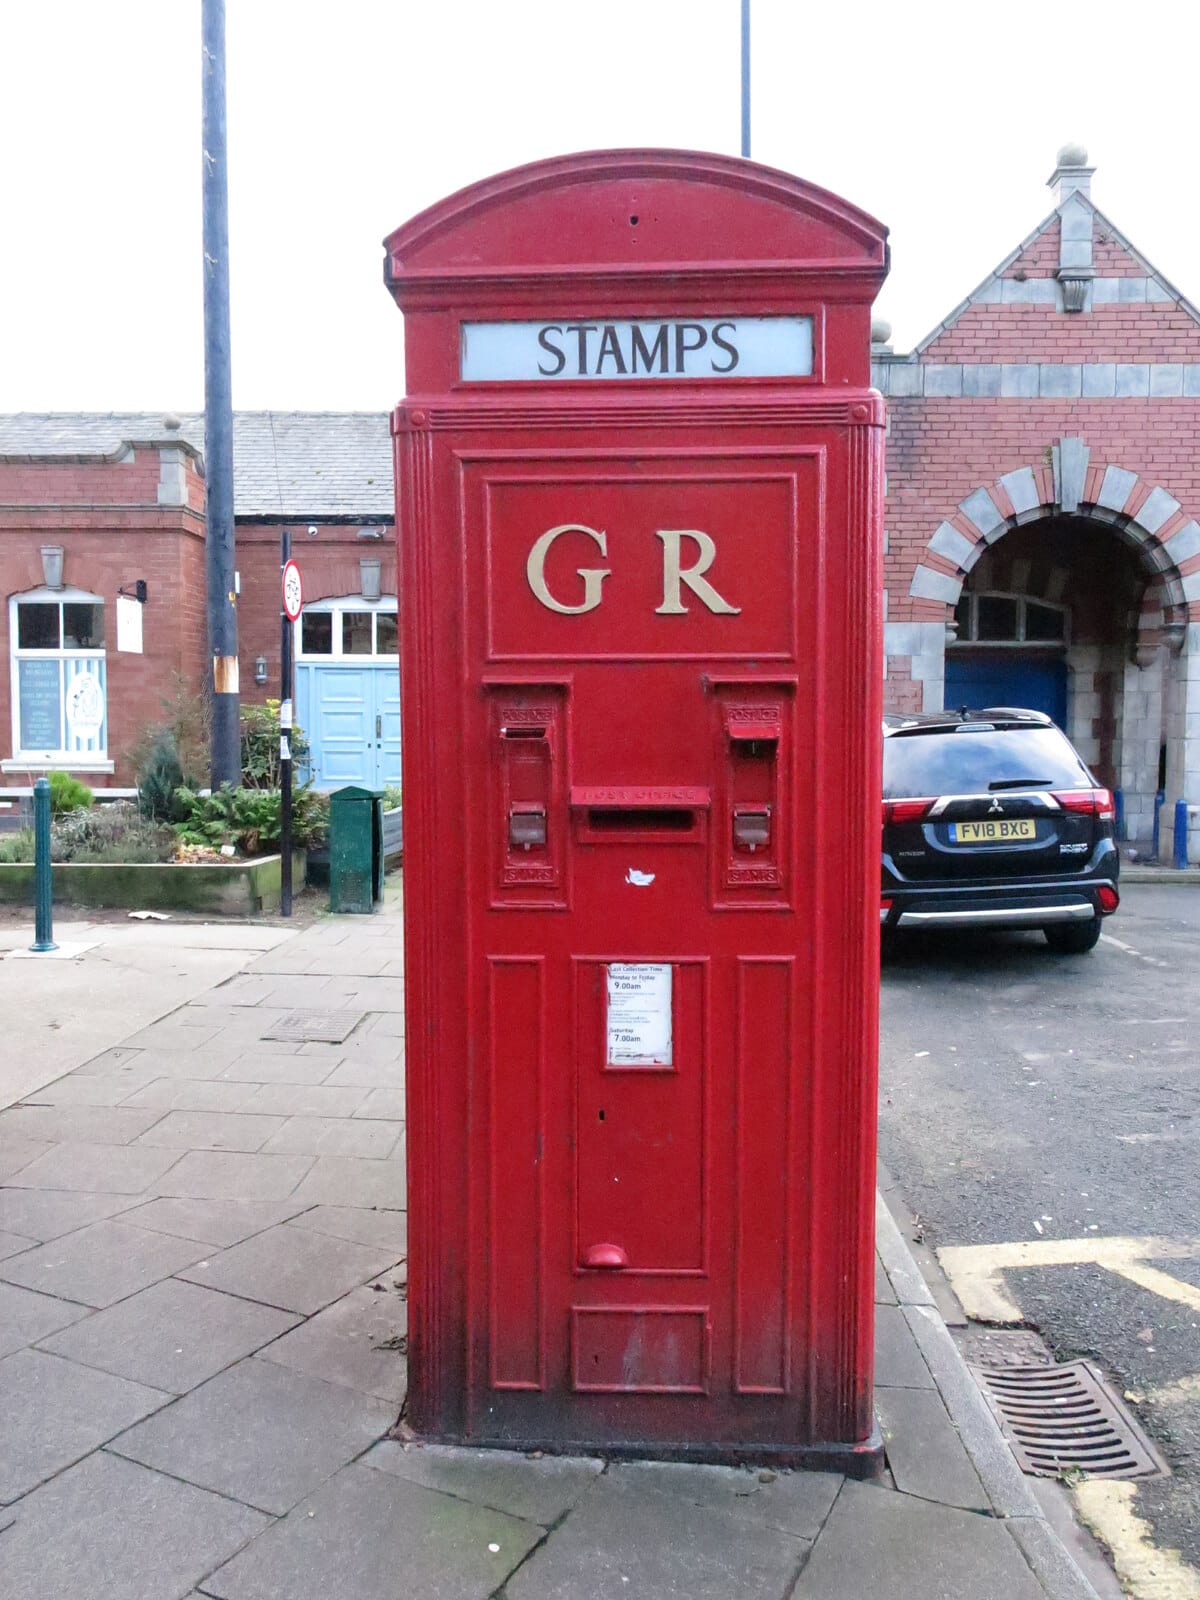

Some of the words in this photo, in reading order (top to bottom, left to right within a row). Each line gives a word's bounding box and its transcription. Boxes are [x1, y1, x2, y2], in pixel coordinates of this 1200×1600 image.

[537, 322, 740, 377] STAMPS
[526, 523, 611, 615] G
[655, 529, 741, 615] R
[961, 823, 996, 838] FV18
[1000, 822, 1029, 837] BXG
[614, 981, 642, 990] 9.00am
[614, 1033, 641, 1042] 7.00am
